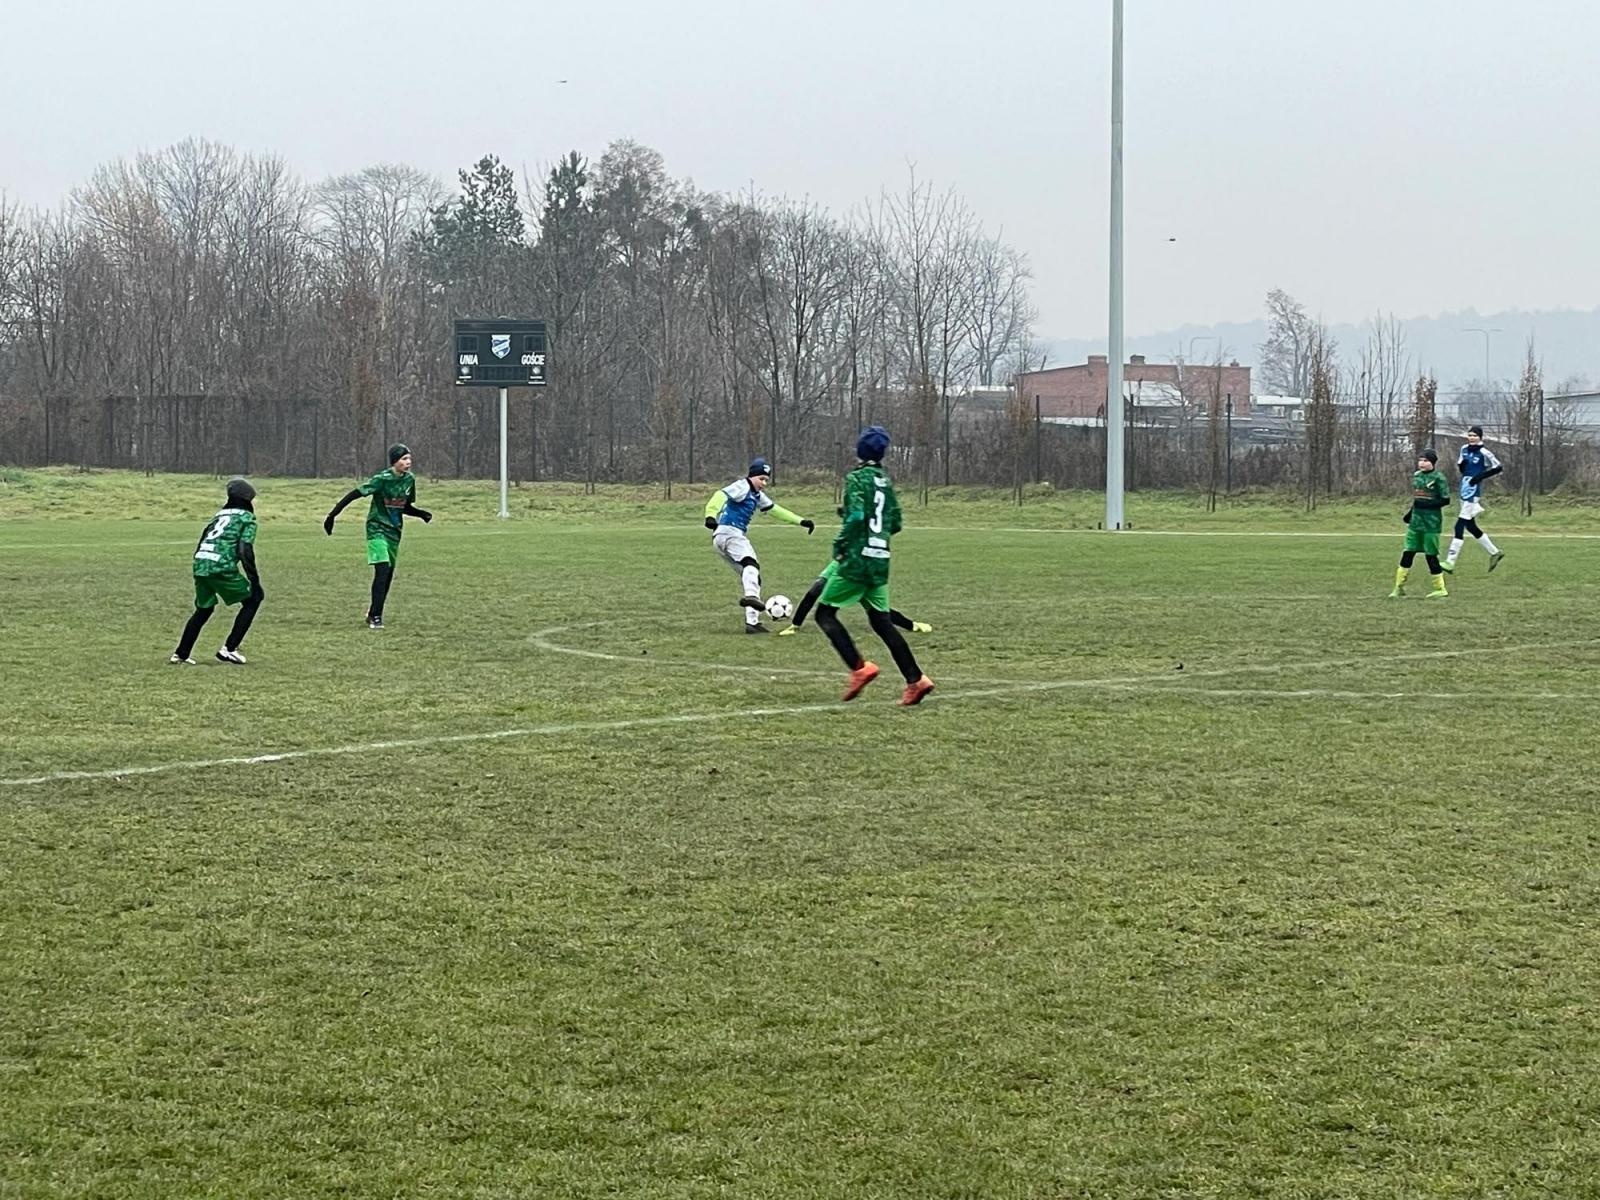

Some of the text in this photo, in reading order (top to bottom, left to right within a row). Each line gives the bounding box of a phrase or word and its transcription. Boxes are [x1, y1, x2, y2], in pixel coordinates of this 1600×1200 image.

[459, 354, 479, 365] UNIA
[868, 490, 886, 534] 3
[206, 515, 231, 540] 8
